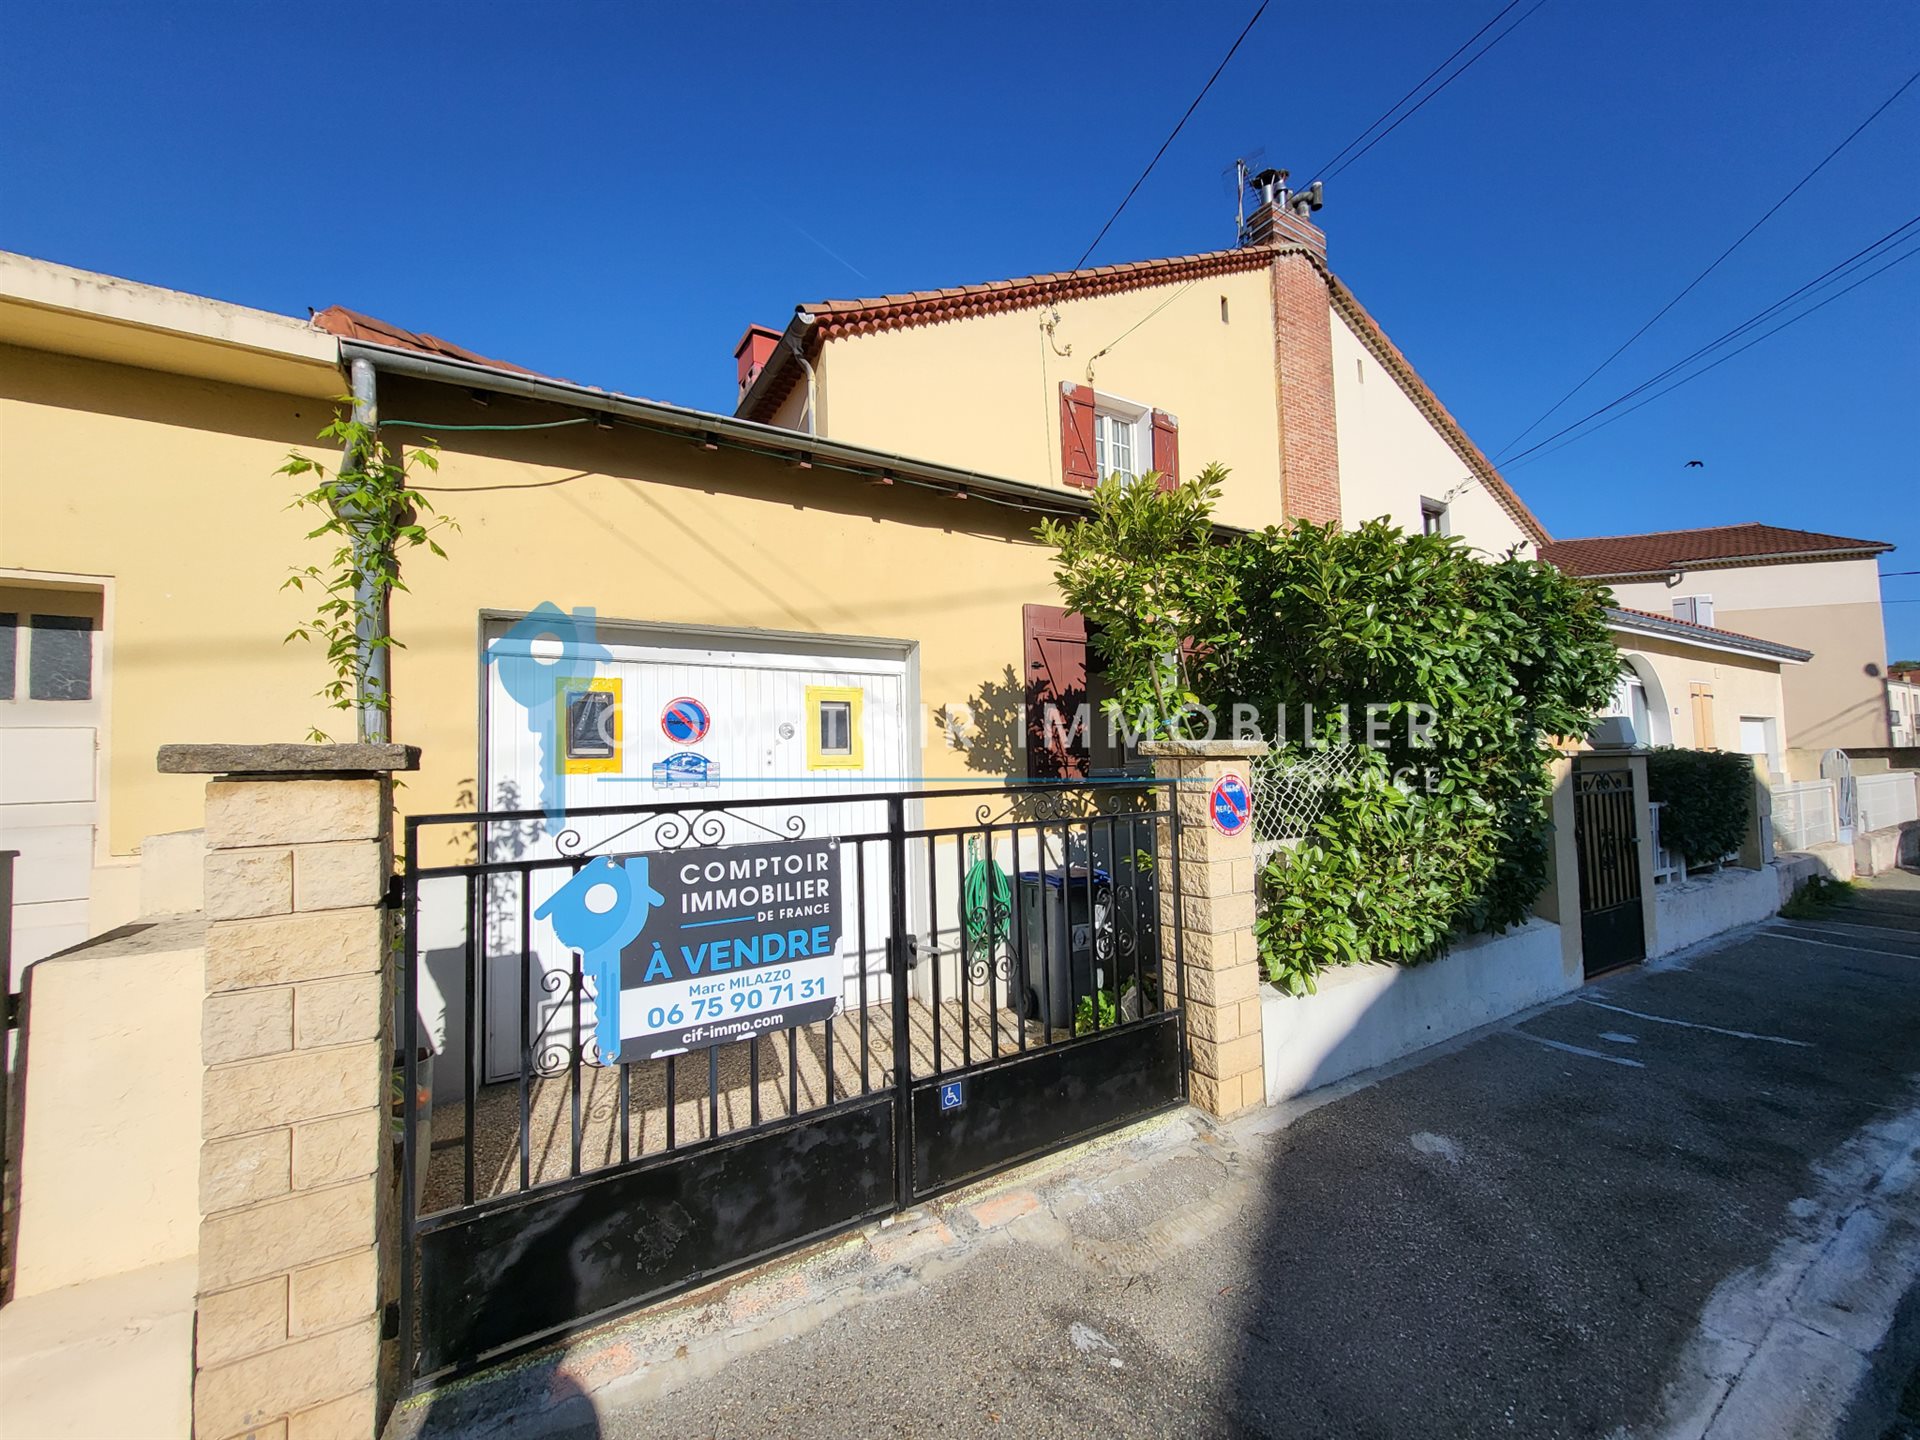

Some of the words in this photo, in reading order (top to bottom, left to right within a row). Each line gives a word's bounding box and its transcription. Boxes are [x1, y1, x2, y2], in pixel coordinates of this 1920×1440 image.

[680, 852, 829, 885] COMPTOIR
[681, 878, 829, 914] IMMOBILIER
[757, 911, 774, 922] DE
[779, 903, 830, 919] FRANCE
[643, 942, 673, 982] À
[680, 925, 831, 975] VENDRE
[689, 983, 726, 997] Marc
[729, 969, 791, 989] MILAZZO
[647, 1004, 684, 1028] 06
[691, 996, 723, 1020] 75
[730, 990, 763, 1012] 90
[769, 983, 794, 1004] 71
[801, 977, 825, 998] 31
[682, 1013, 784, 1044] cif-immo.com
